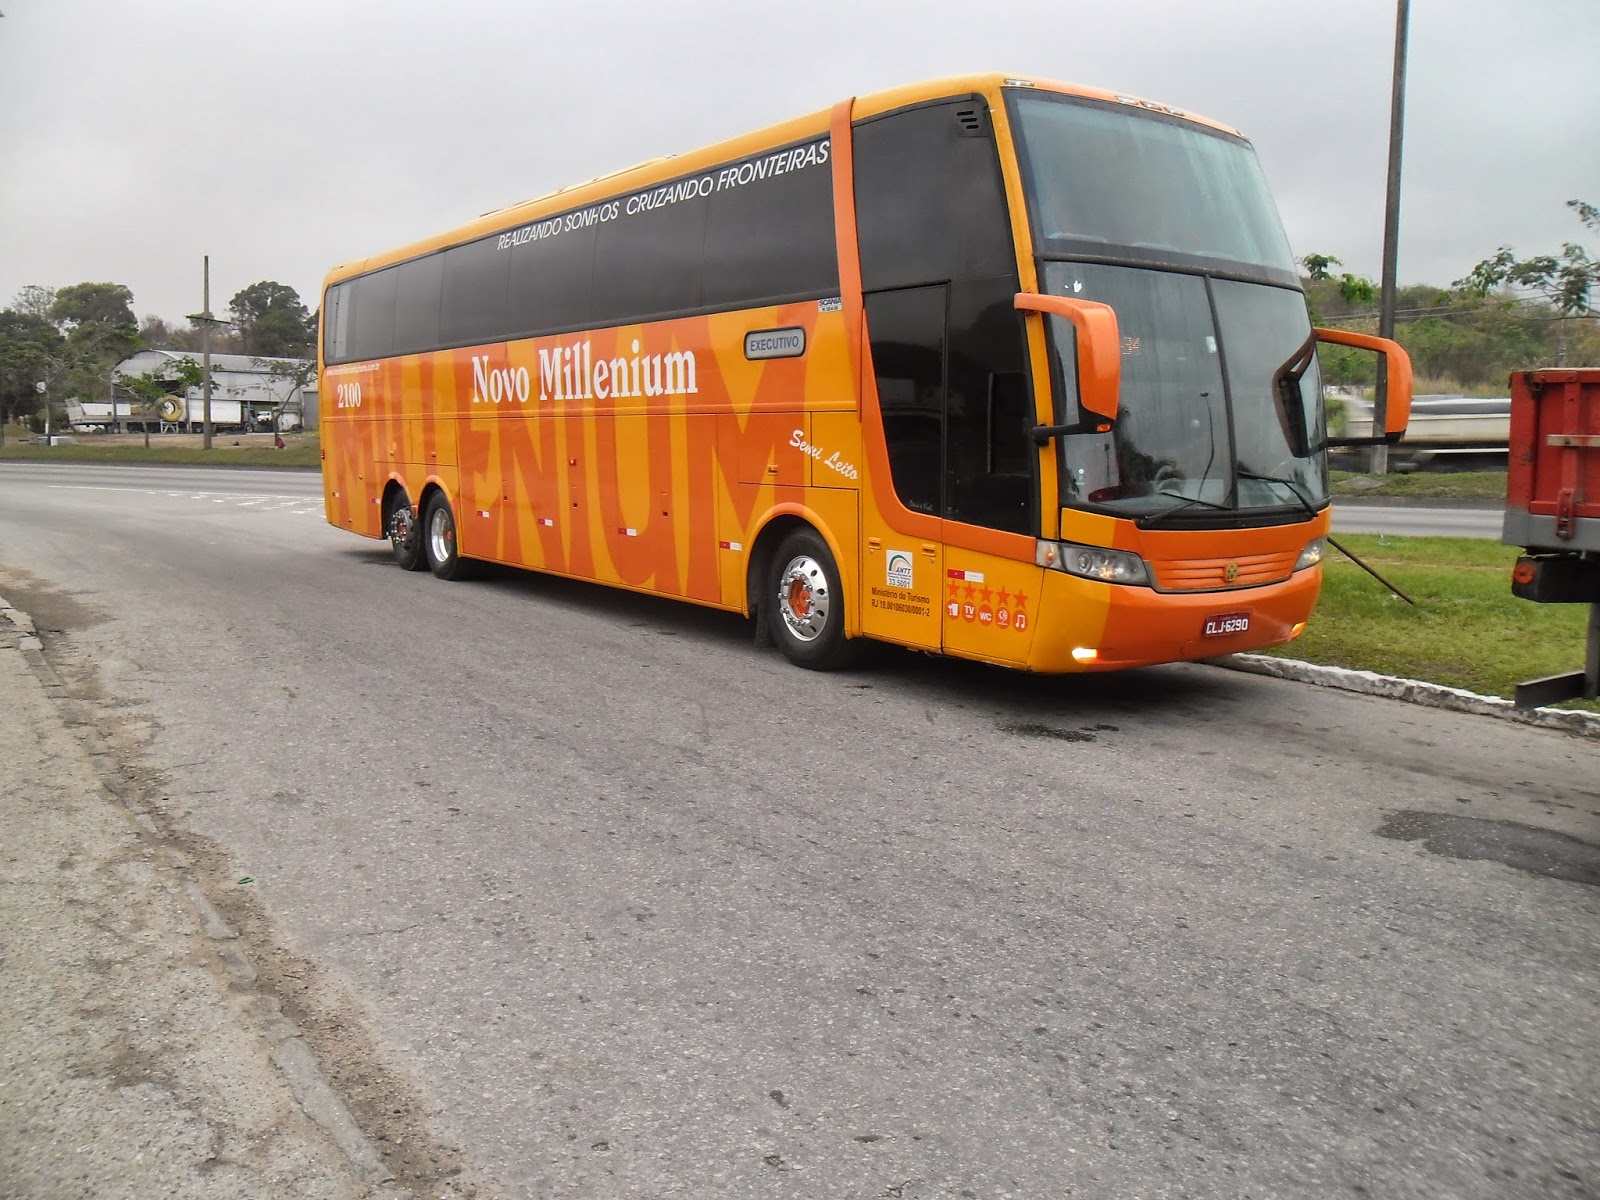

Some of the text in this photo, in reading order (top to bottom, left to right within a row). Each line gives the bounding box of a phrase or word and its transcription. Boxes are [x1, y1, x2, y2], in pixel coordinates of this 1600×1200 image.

[497, 140, 831, 250] REALIZANDO SONHOS CRUZANDO FRONTEIRAS
[750, 335, 799, 351] EXECUTIVO
[472, 339, 698, 404] Novo Millenium
[337, 382, 362, 408] 2100
[789, 429, 859, 481] Semi Leito
[896, 566, 912, 575] ANTT
[871, 598, 879, 608] RJ
[899, 592, 906, 600] do
[907, 592, 930, 604] Turismo
[963, 605, 975, 615] TV
[979, 611, 992, 621] WC
